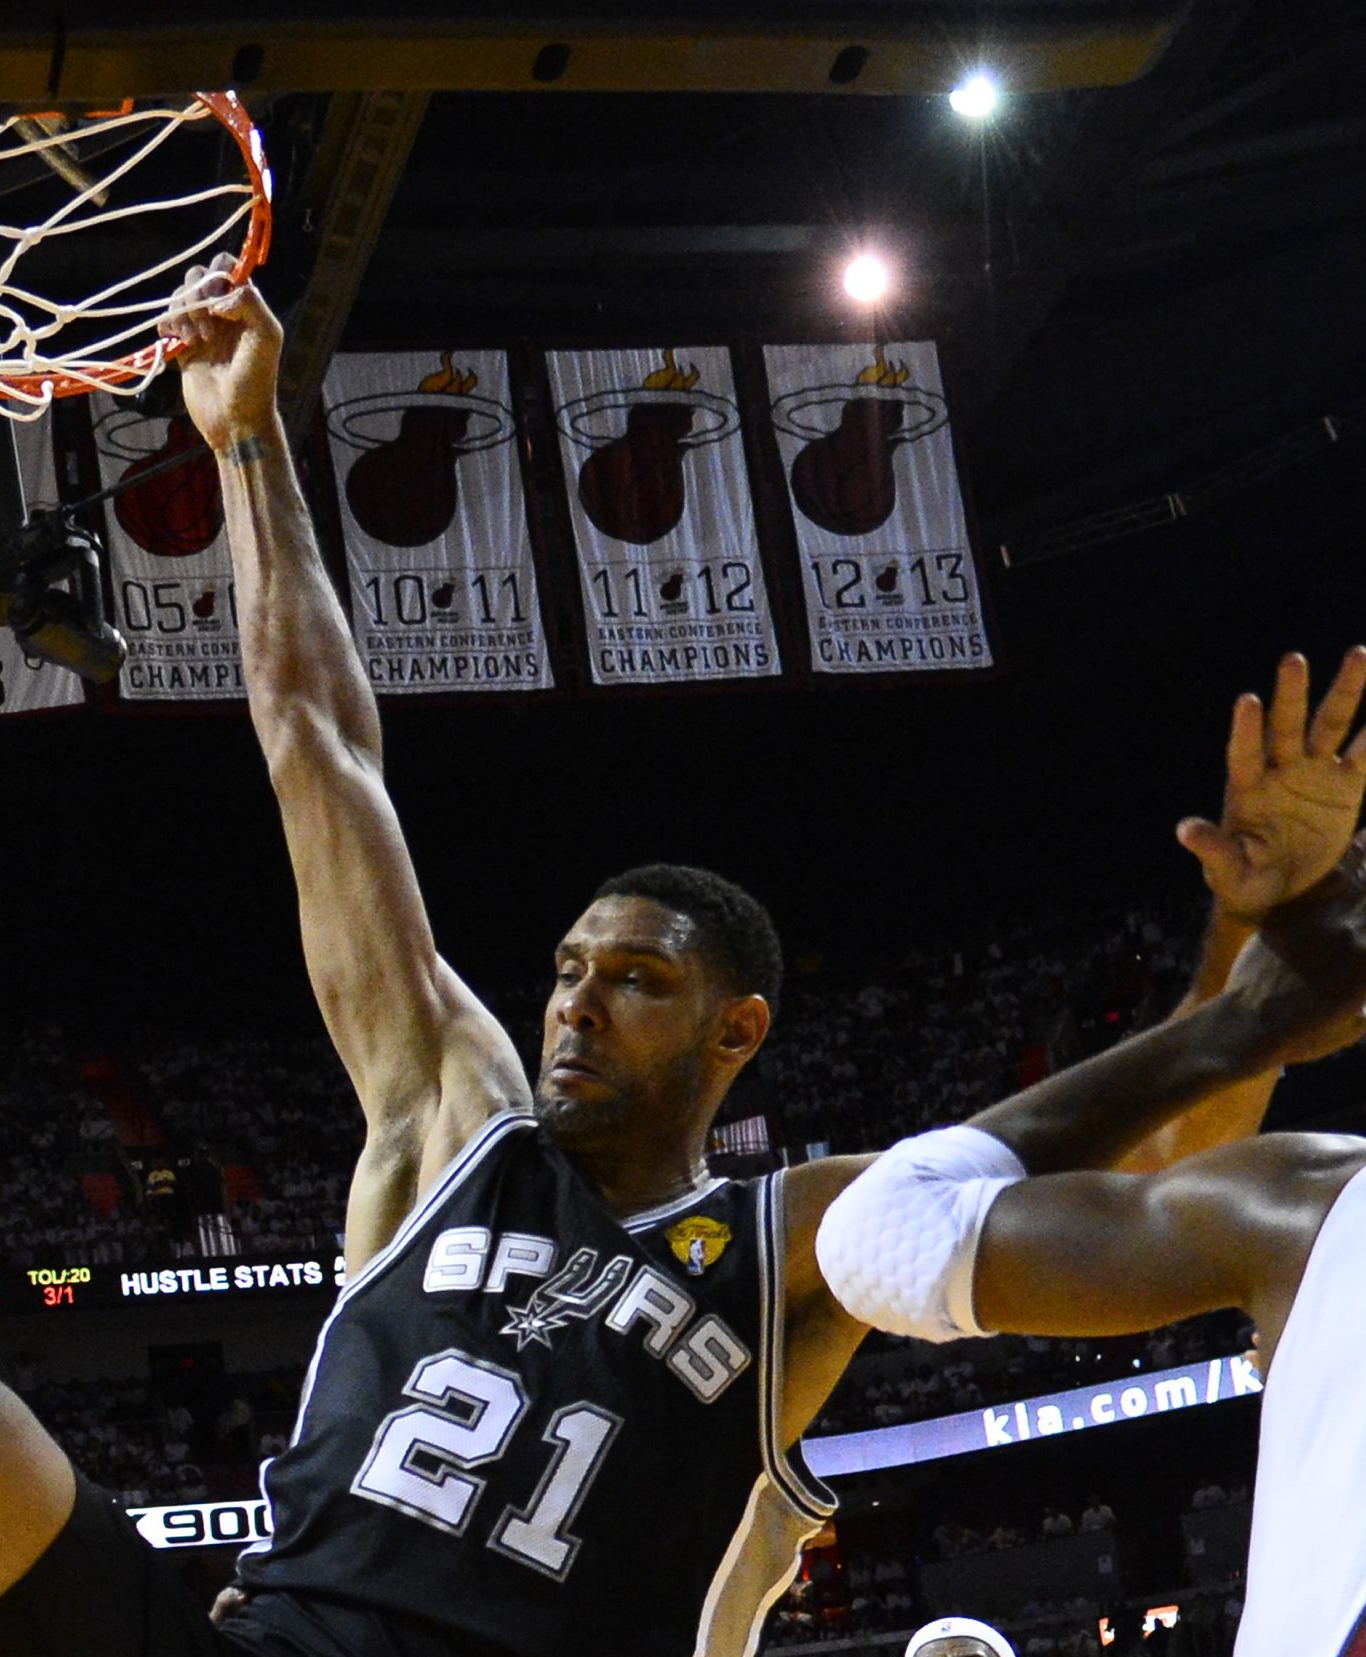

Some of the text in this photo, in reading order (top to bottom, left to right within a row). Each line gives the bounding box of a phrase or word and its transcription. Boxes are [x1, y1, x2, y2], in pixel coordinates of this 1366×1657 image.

[593, 561, 755, 618] 11 12
[811, 553, 968, 609] 12 13
[122, 580, 186, 633] 05
[365, 572, 528, 626] 10 11
[597, 621, 763, 642] EASTERN CONFERENCE
[886, 612, 979, 631] CONFERENCE
[127, 642, 195, 657] EASTERN
[367, 630, 536, 650] EASTERN CONFERENCE
[819, 633, 985, 664] CHAMPIONS
[369, 652, 539, 682] CHAMPIONS
[599, 643, 770, 674] CHAMPIONS
[130, 662, 245, 689] CHAMPI
[121, 1261, 229, 1297] HUSTLE
[235, 1257, 323, 1290] STATS
[43, 1285, 75, 1306] 3/1
[422, 1226, 752, 1404] SPURS
[349, 1348, 625, 1583] 21
